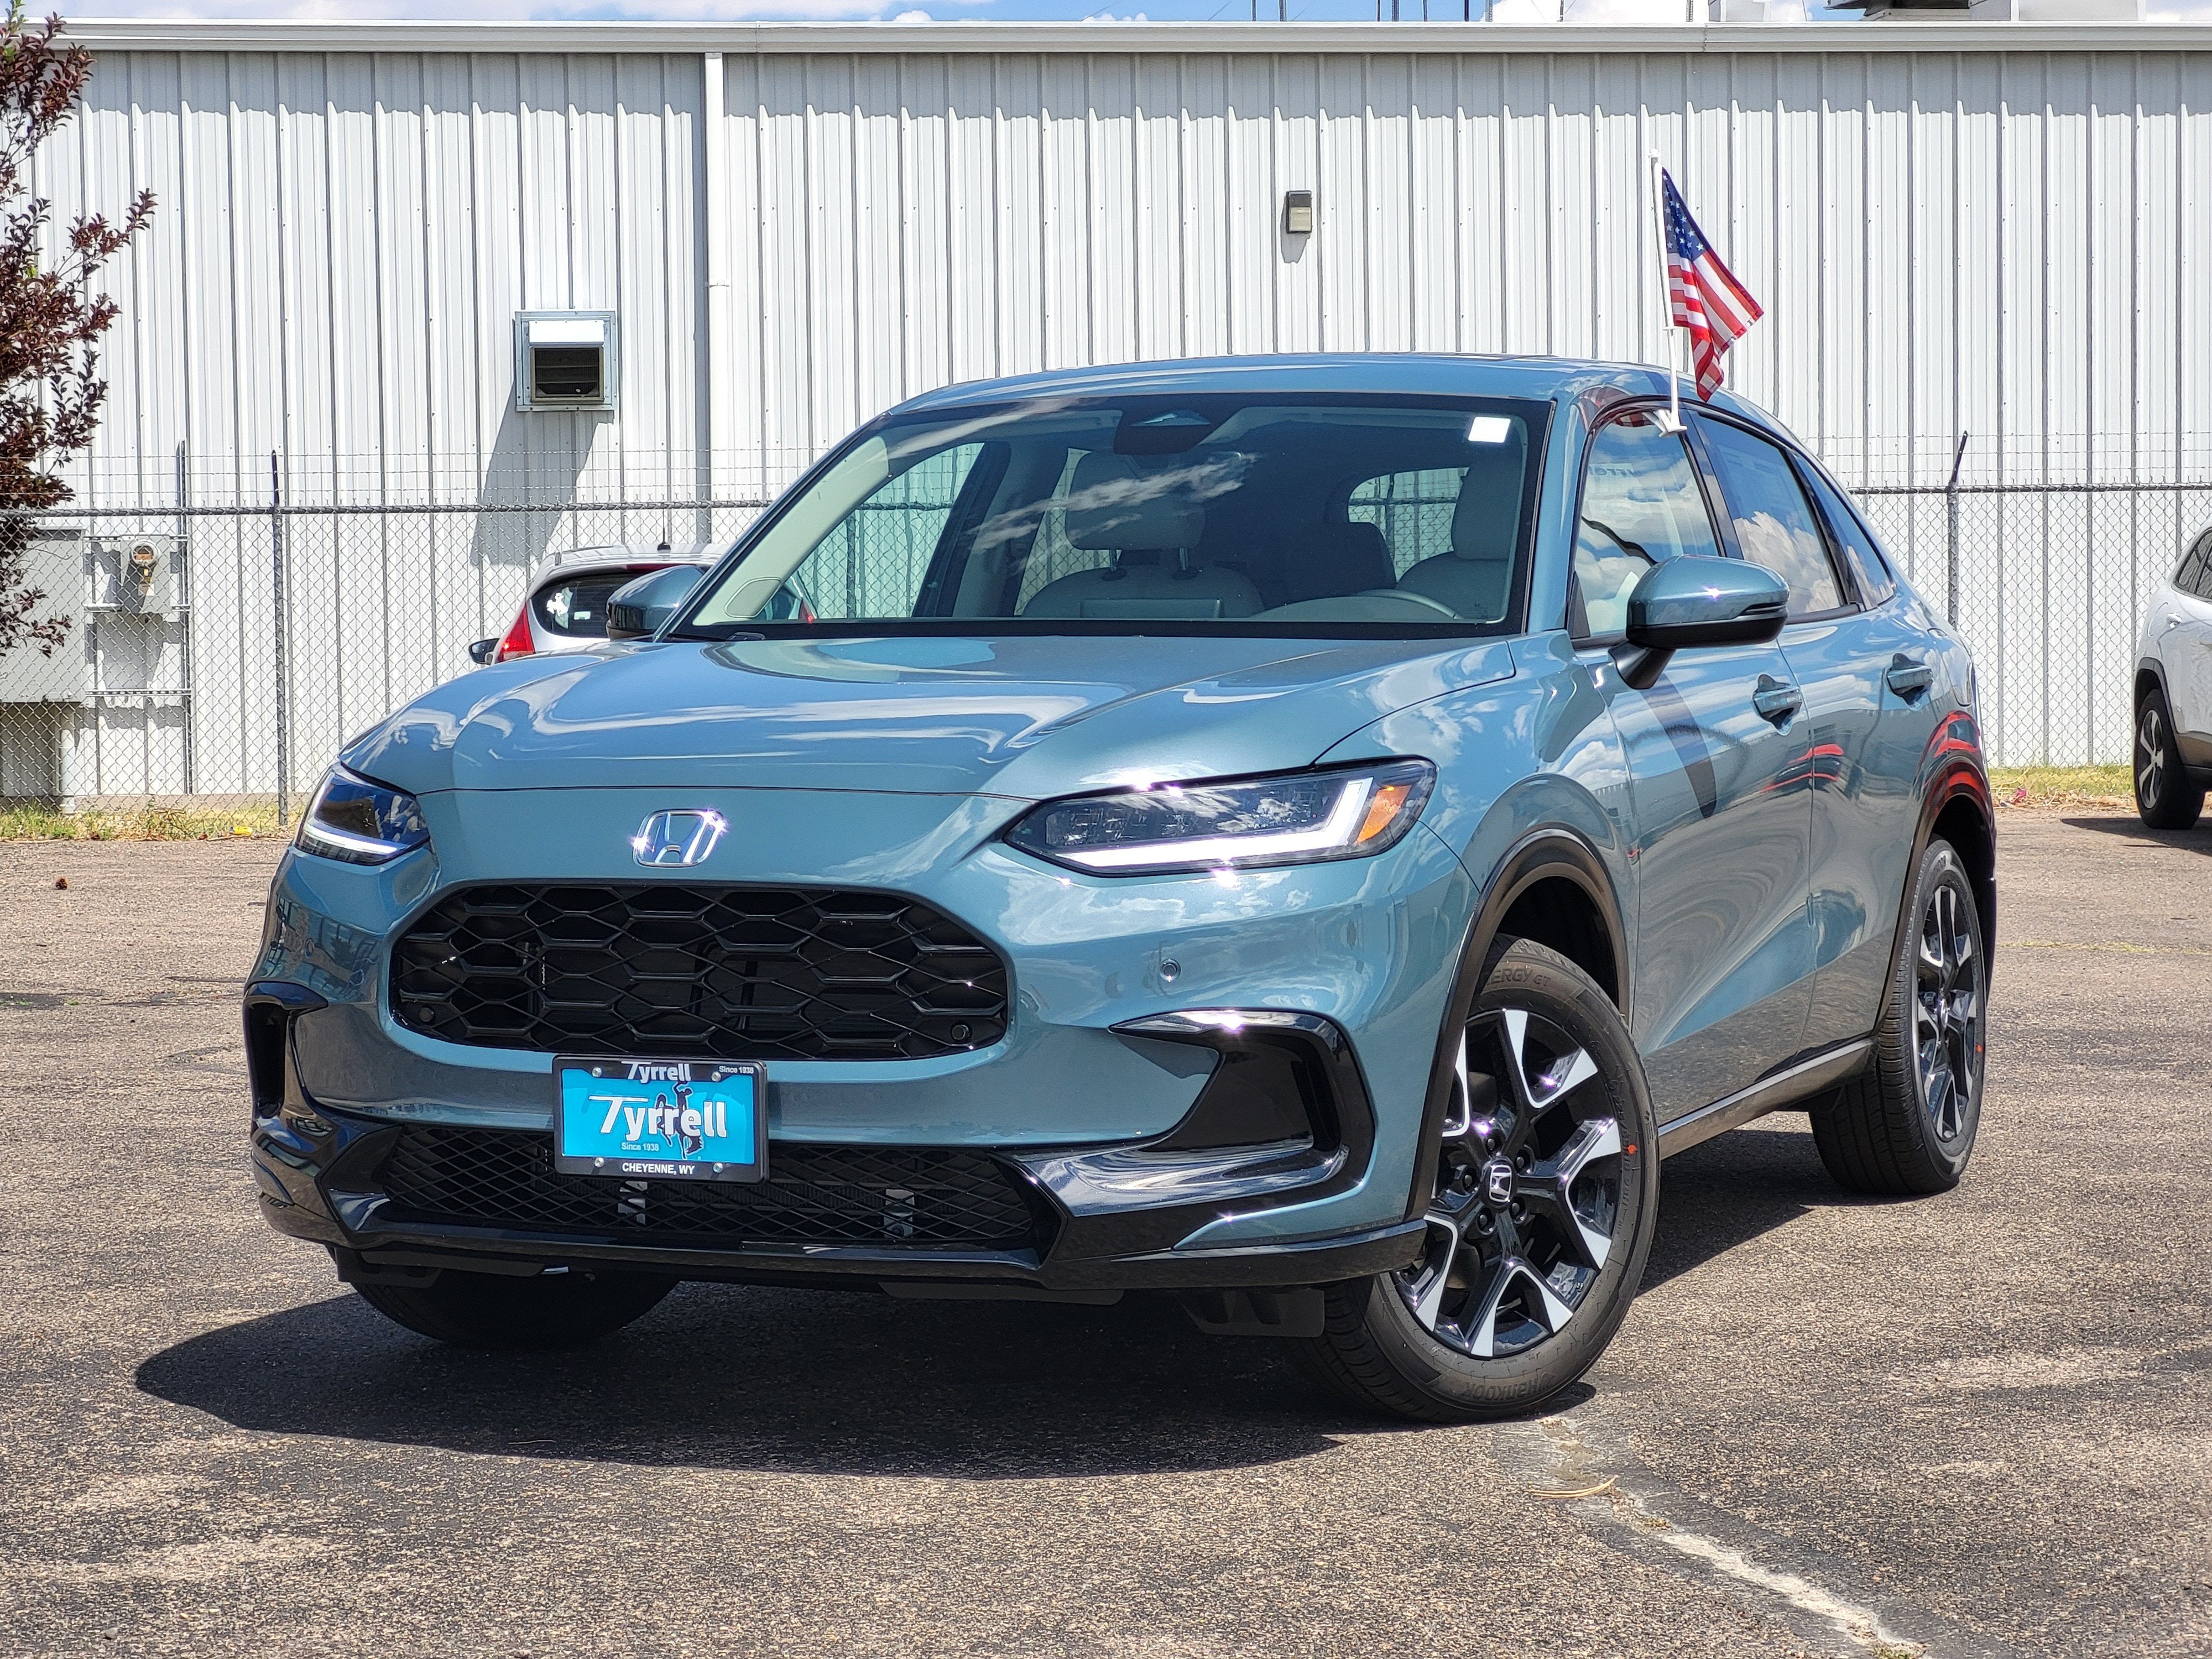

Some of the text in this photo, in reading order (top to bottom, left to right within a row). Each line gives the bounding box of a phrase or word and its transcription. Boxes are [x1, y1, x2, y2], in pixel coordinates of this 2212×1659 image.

[1488, 968, 1534, 985] ERGY
[621, 1061, 692, 1084] Tyrrell
[718, 1065, 754, 1074] Since 1938
[588, 1095, 727, 1141] Tyrrell
[621, 1142, 660, 1151] Since 1938
[622, 1162, 696, 1175] CHEYENNE, WY
